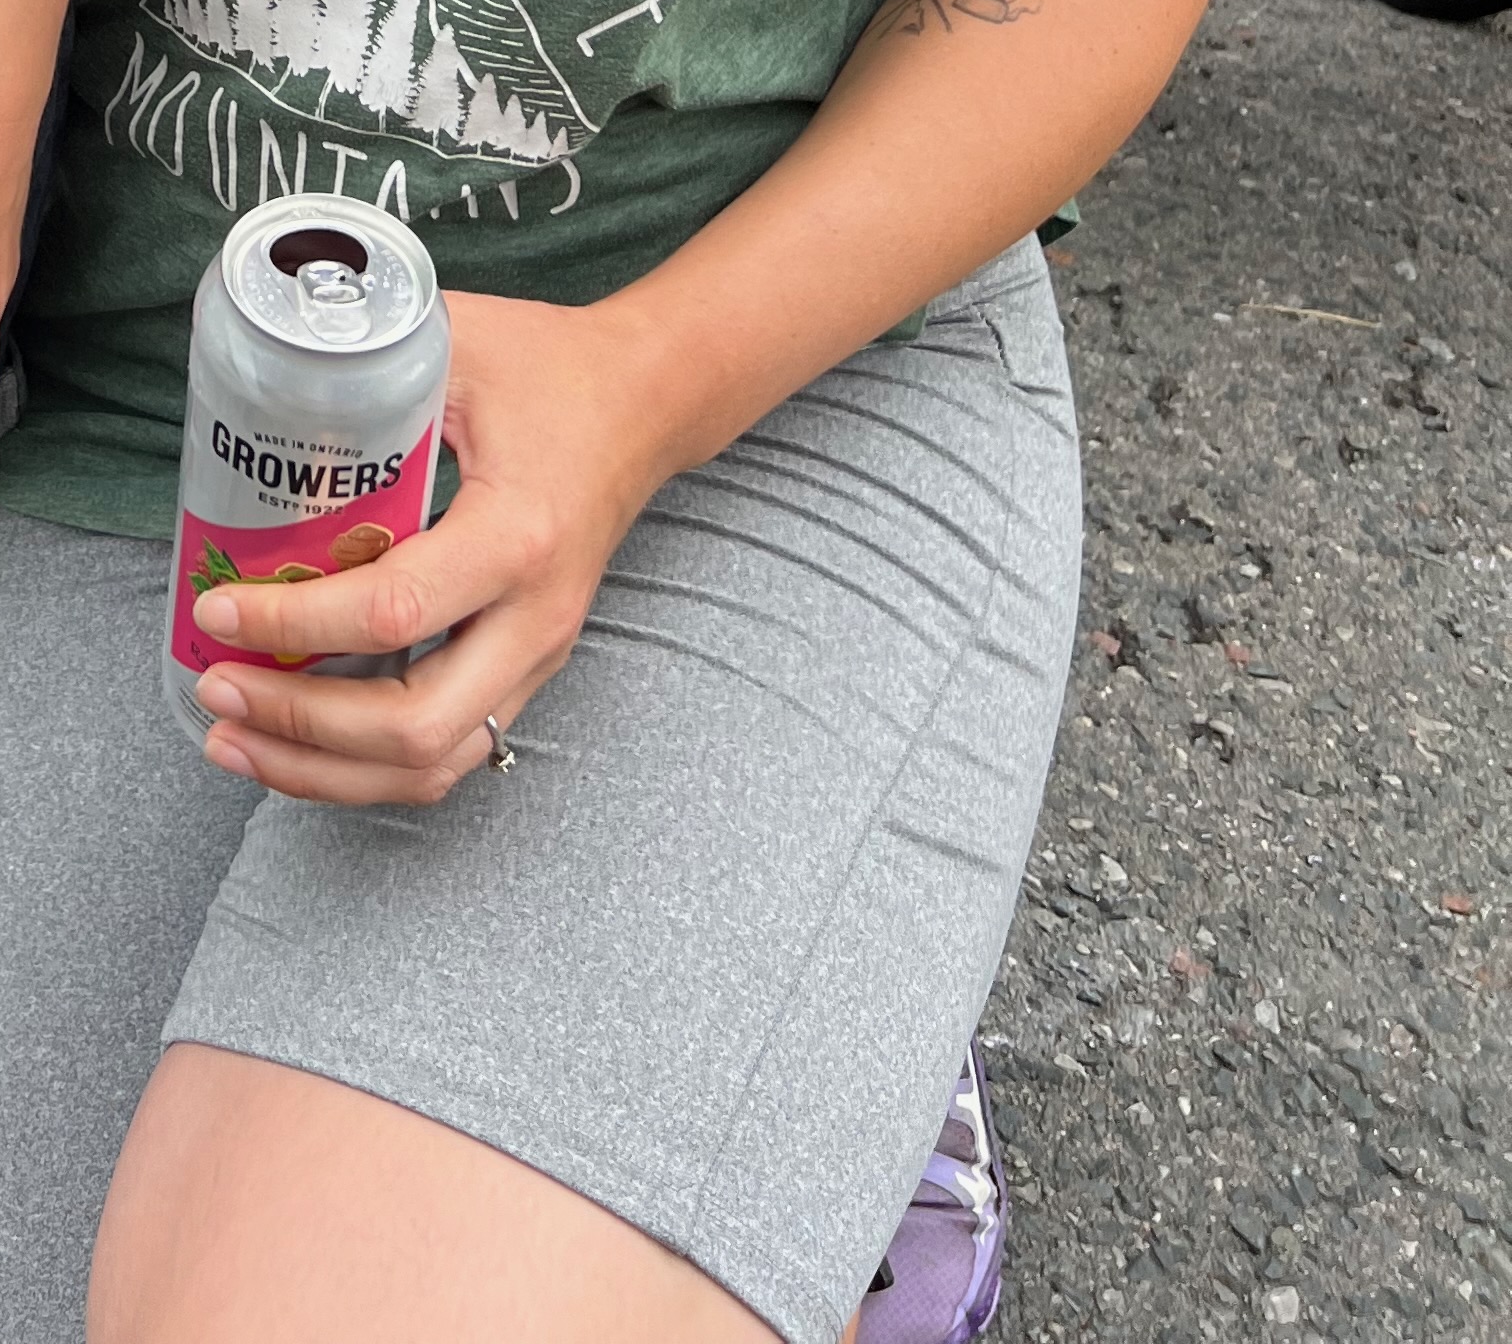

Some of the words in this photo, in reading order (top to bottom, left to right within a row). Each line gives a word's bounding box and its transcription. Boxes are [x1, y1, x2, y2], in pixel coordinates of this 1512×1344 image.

[212, 419, 404, 499] GROWERS
[253, 431, 287, 447] MADE
[291, 439, 305, 450] IN
[309, 443, 364, 459] ONTARIO
